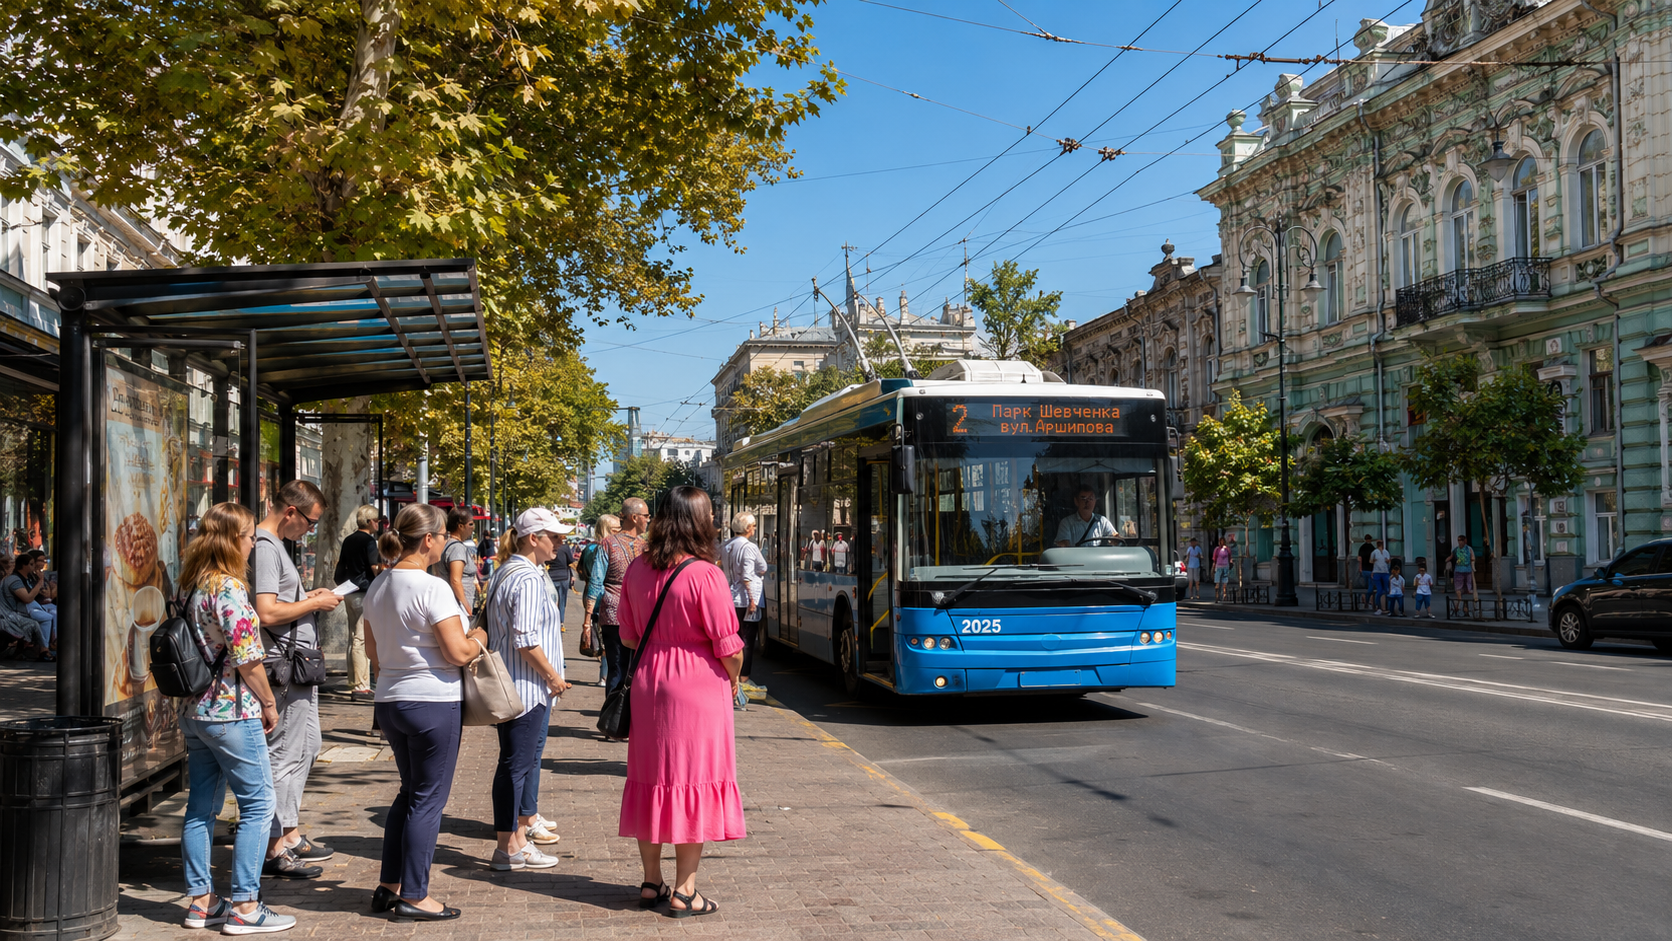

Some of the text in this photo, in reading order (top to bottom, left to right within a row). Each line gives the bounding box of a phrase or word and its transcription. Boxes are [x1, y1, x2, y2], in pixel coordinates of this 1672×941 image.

[952, 404, 968, 433] 2
[992, 404, 1120, 420] Парк Шевченка
[961, 619, 1002, 634] 2025
